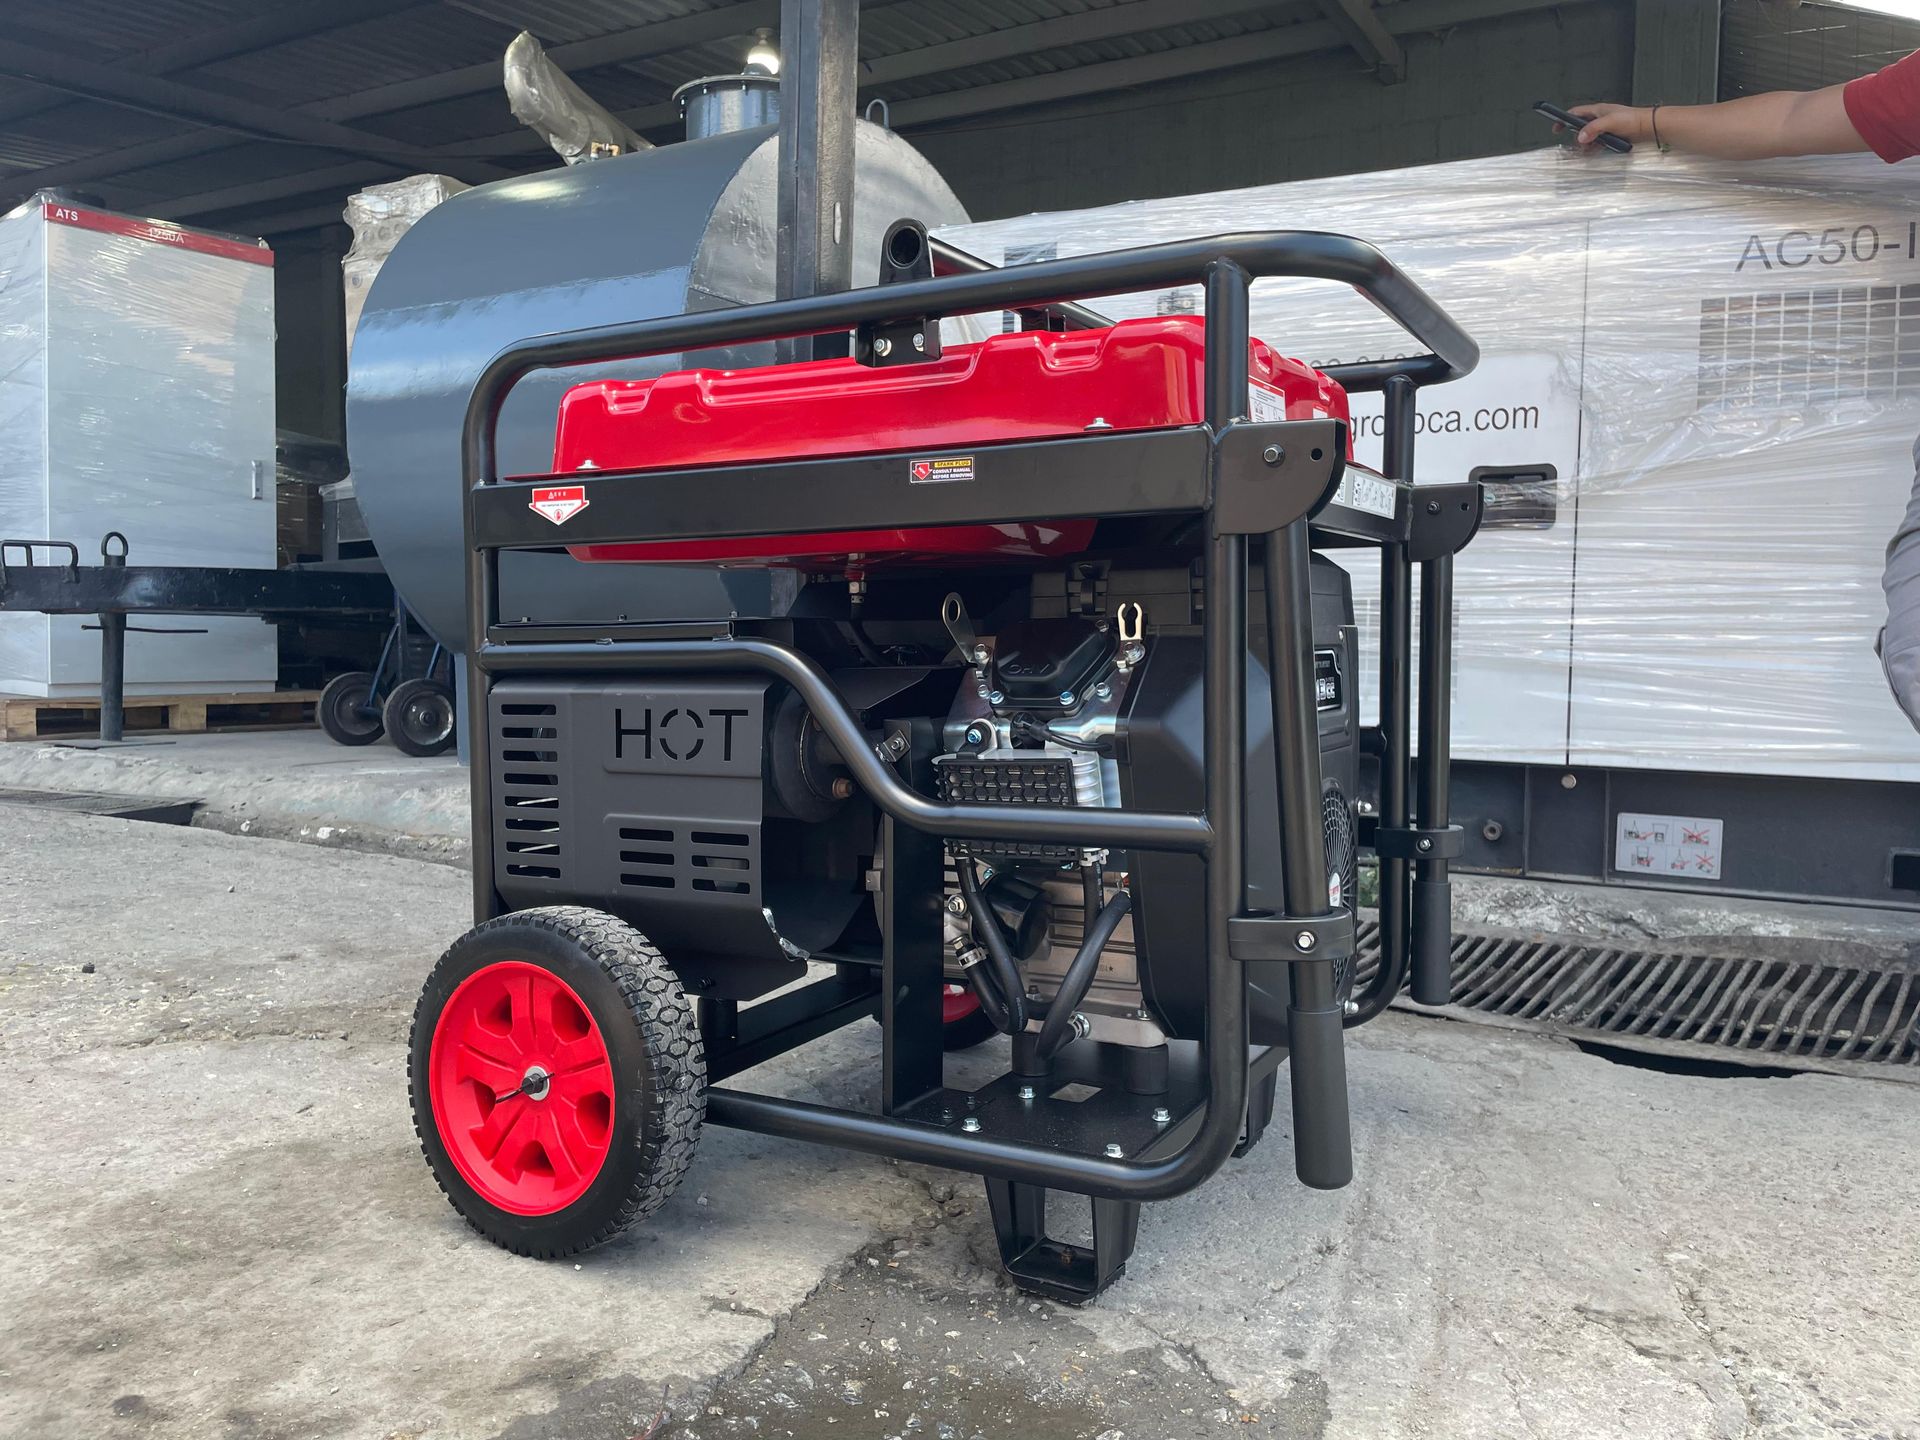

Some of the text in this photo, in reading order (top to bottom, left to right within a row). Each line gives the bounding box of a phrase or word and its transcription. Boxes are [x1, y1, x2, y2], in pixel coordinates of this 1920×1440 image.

[55, 207, 79, 222] ATS
[1735, 221, 1917, 273] AC50-I
[614, 707, 749, 762] HOT
